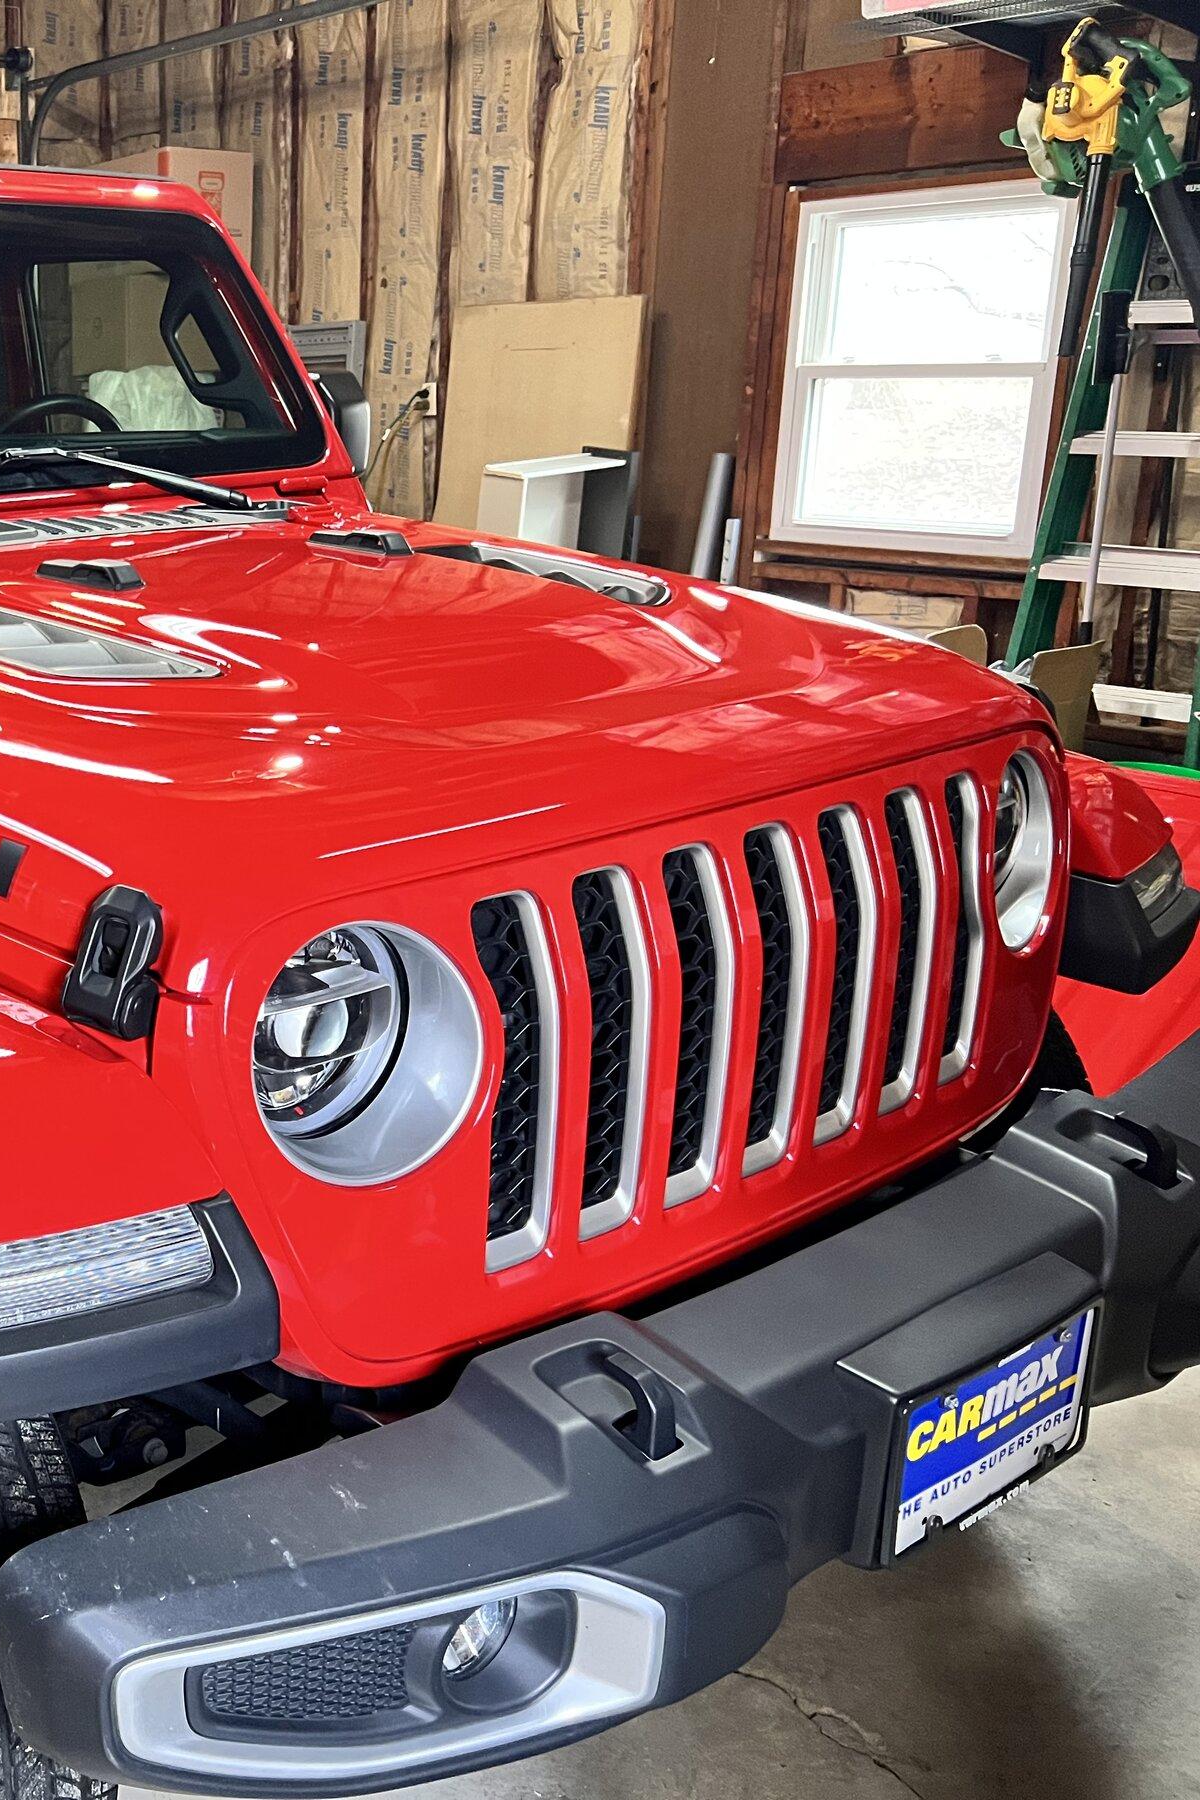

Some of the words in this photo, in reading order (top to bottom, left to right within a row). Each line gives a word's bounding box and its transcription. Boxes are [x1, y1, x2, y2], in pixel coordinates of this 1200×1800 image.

[901, 1499, 922, 1521] HE
[930, 1469, 973, 1501] AUTO
[978, 1406, 1073, 1475] SUPERSTORE
